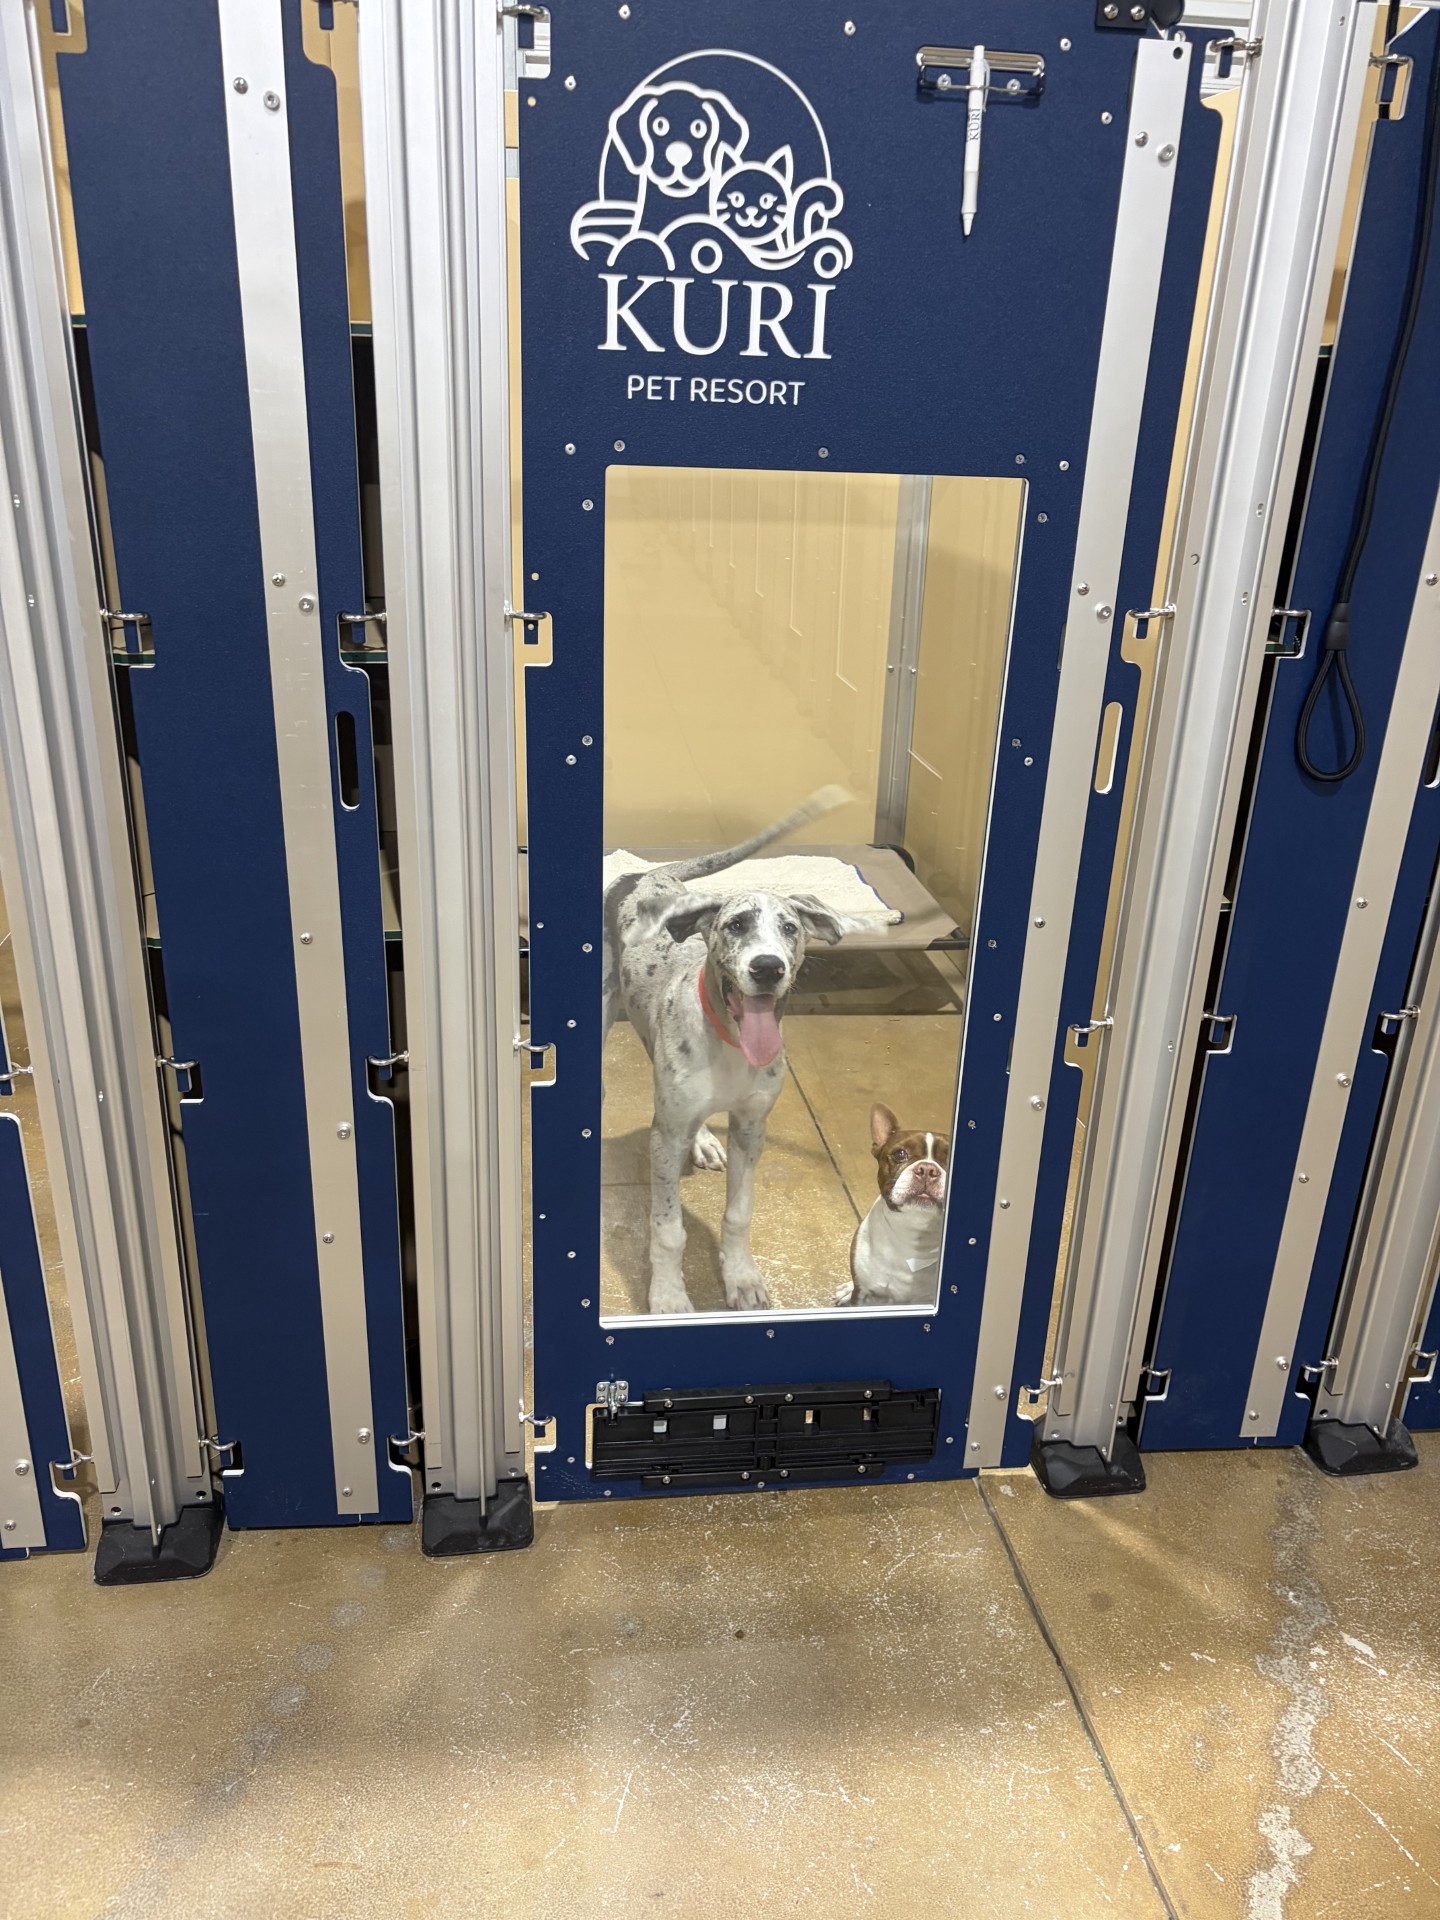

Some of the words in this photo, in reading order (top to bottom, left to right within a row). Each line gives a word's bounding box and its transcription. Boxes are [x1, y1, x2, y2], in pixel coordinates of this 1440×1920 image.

[968, 108, 982, 141] KURI
[597, 273, 836, 359] KURI
[627, 375, 682, 401] PET
[690, 378, 805, 406] RESORT
